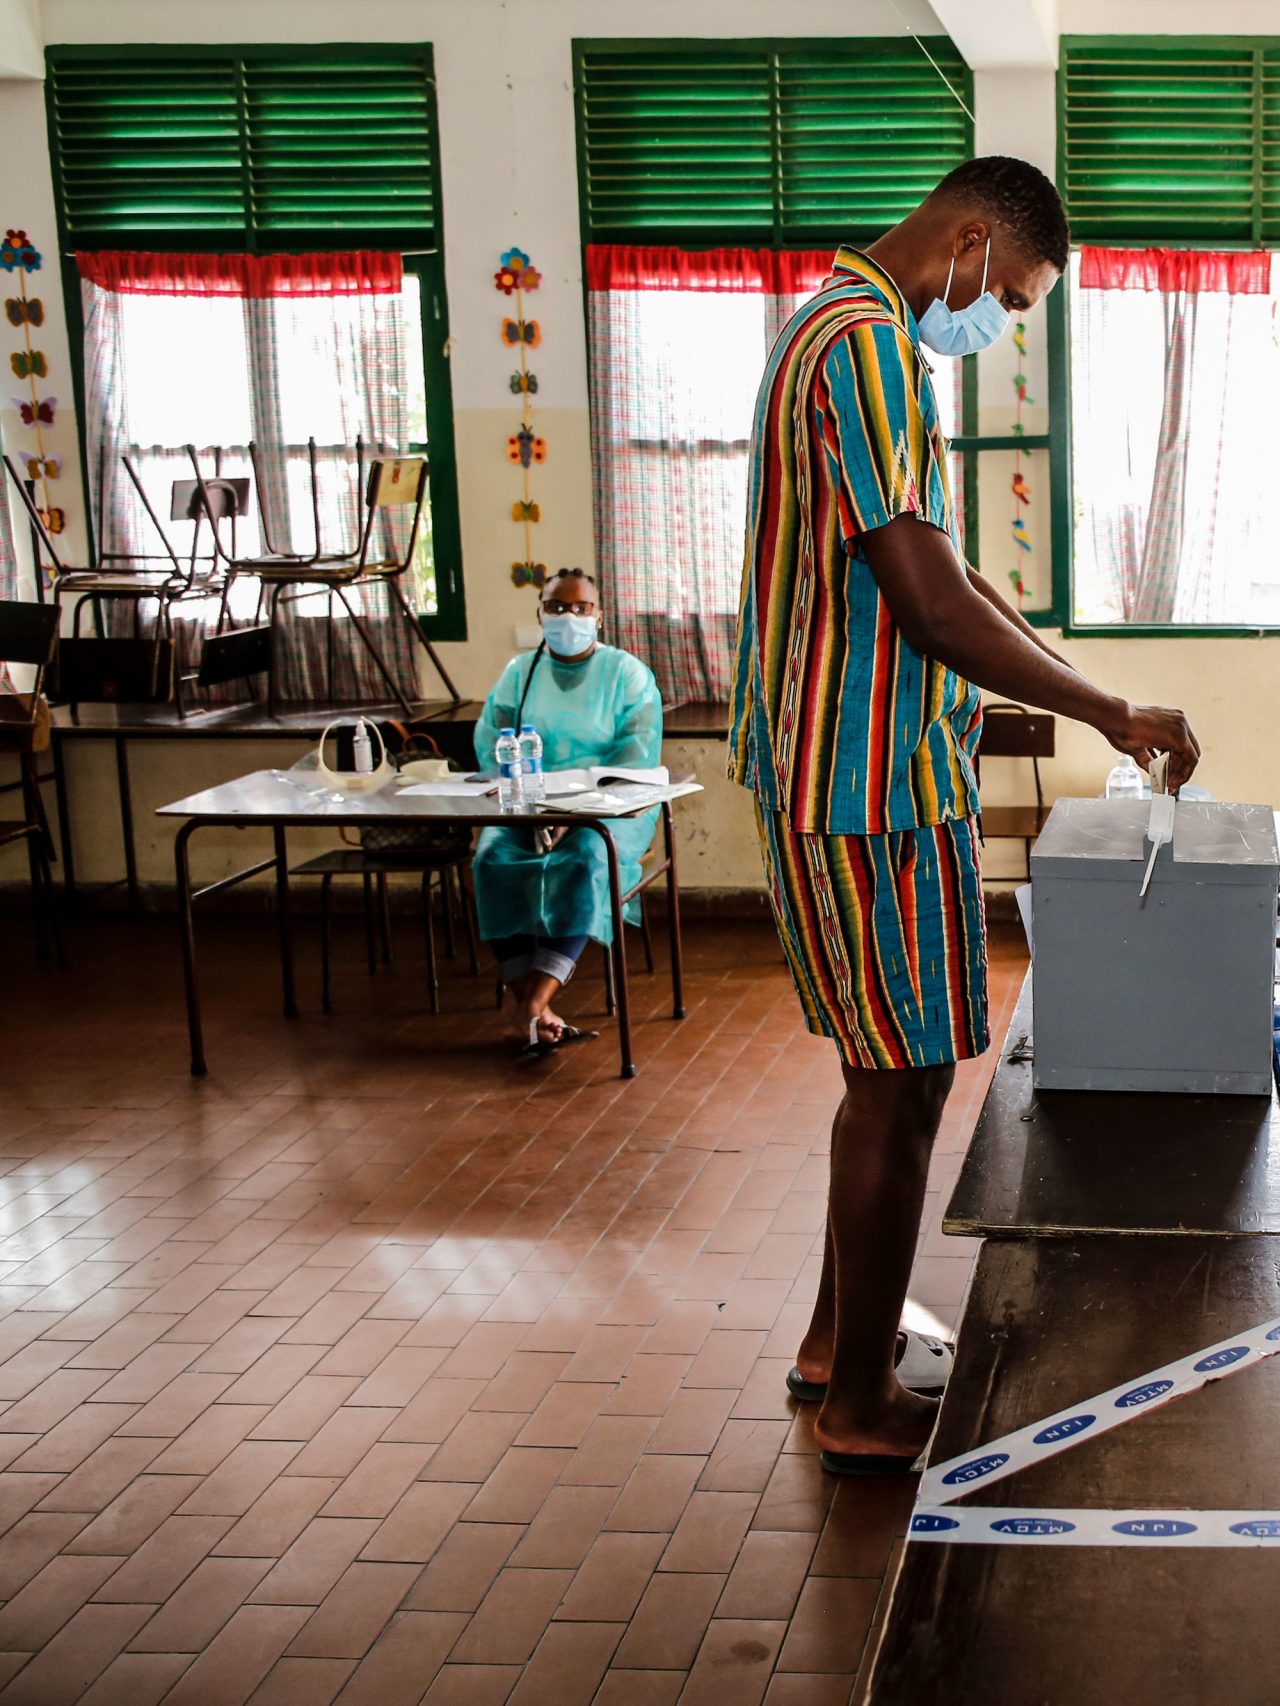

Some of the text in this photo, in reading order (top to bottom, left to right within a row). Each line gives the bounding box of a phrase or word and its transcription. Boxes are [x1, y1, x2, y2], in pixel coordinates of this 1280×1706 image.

[1205, 1350, 1239, 1368] IJN
[1126, 1384, 1170, 1407] MTCV
[1045, 1420, 1083, 1440] IJN
[955, 1458, 1004, 1484] MTCV
[915, 1518, 939, 1527] IJ
[1001, 1524, 1064, 1534] MTCV
[1131, 1523, 1177, 1532] IJN
